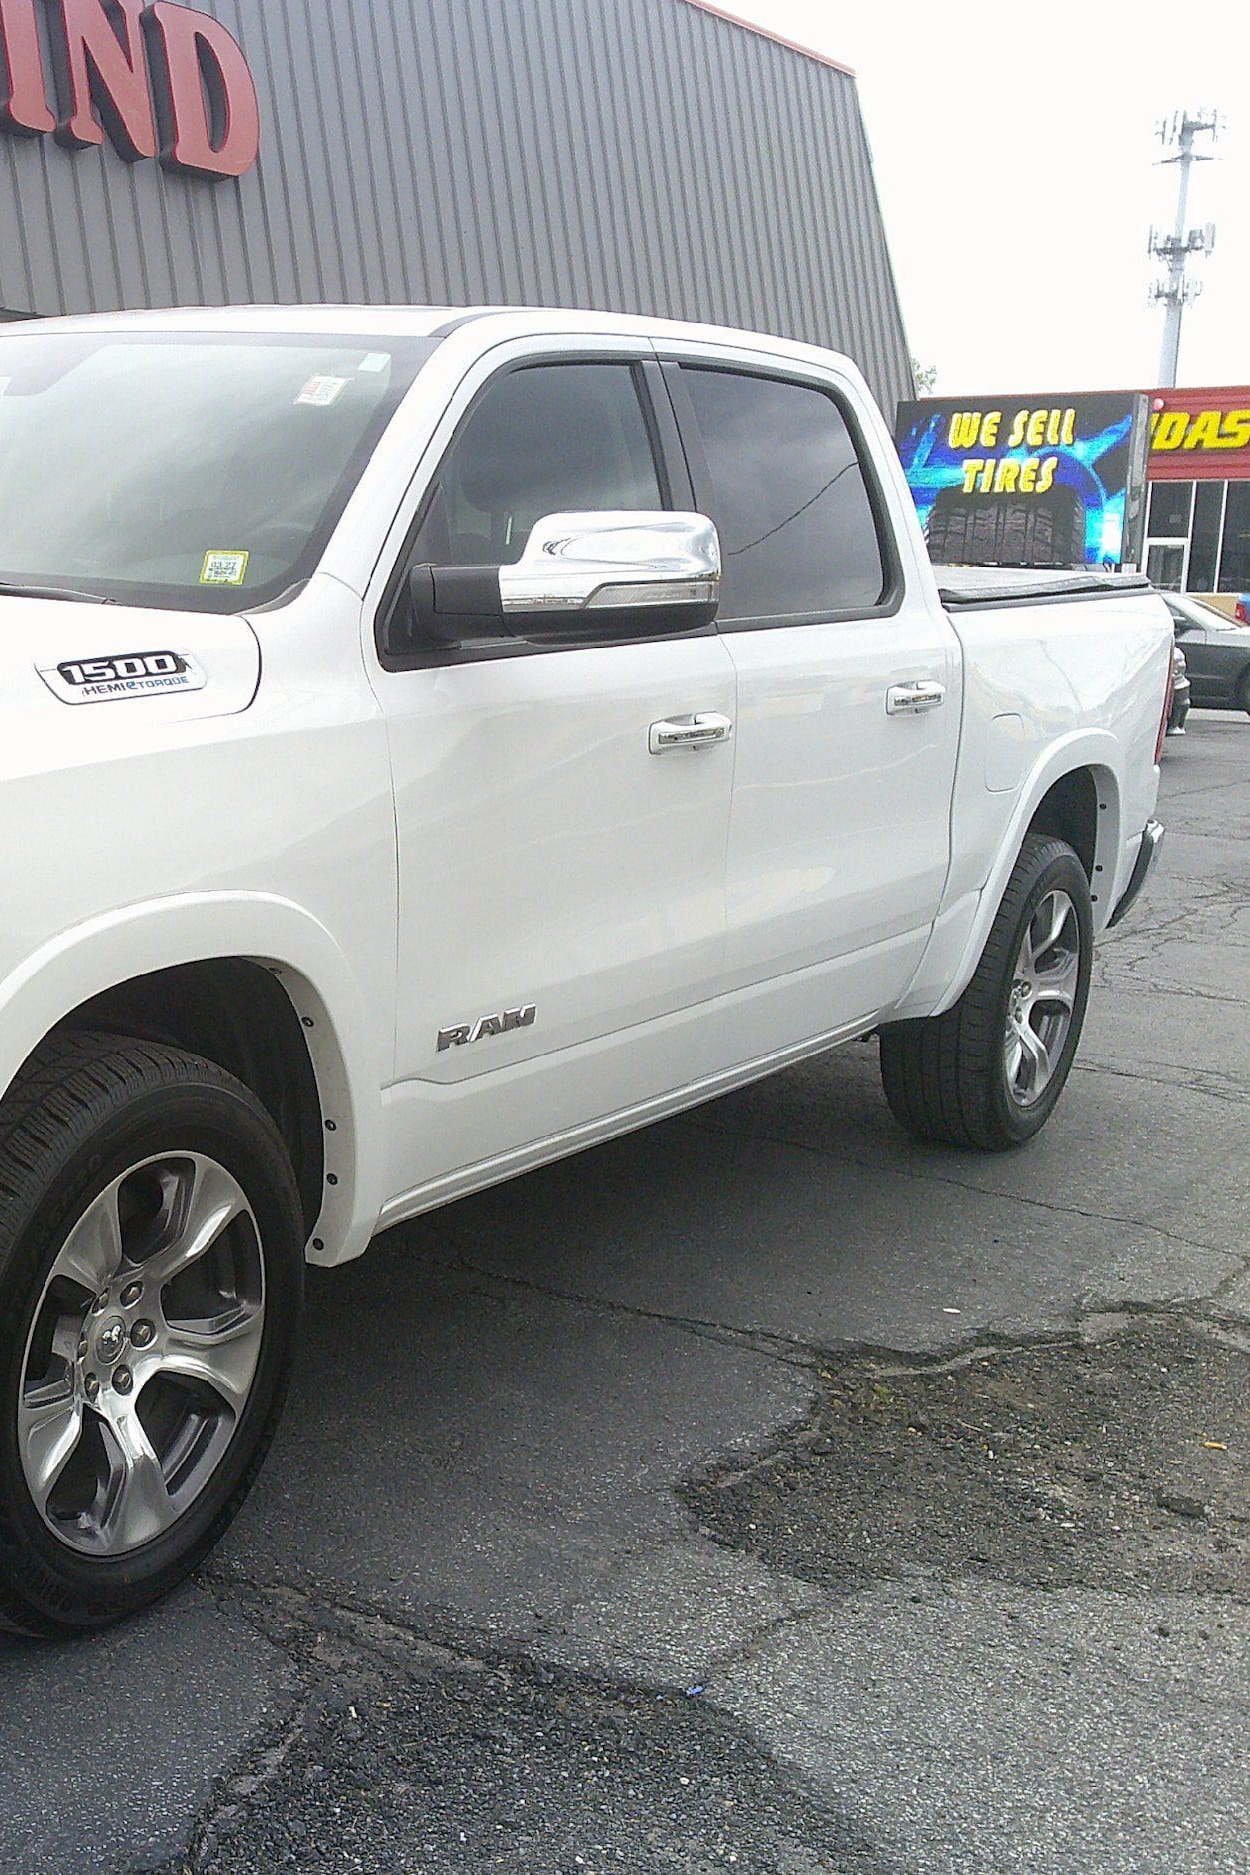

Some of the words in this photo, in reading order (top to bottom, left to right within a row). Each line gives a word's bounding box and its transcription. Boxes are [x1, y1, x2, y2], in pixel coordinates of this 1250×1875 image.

[949, 411, 1002, 449] WE
[1008, 408, 1076, 448] SELL
[962, 456, 1058, 494] TIRES
[62, 654, 178, 684] 1500
[436, 1003, 537, 1053] RAM
